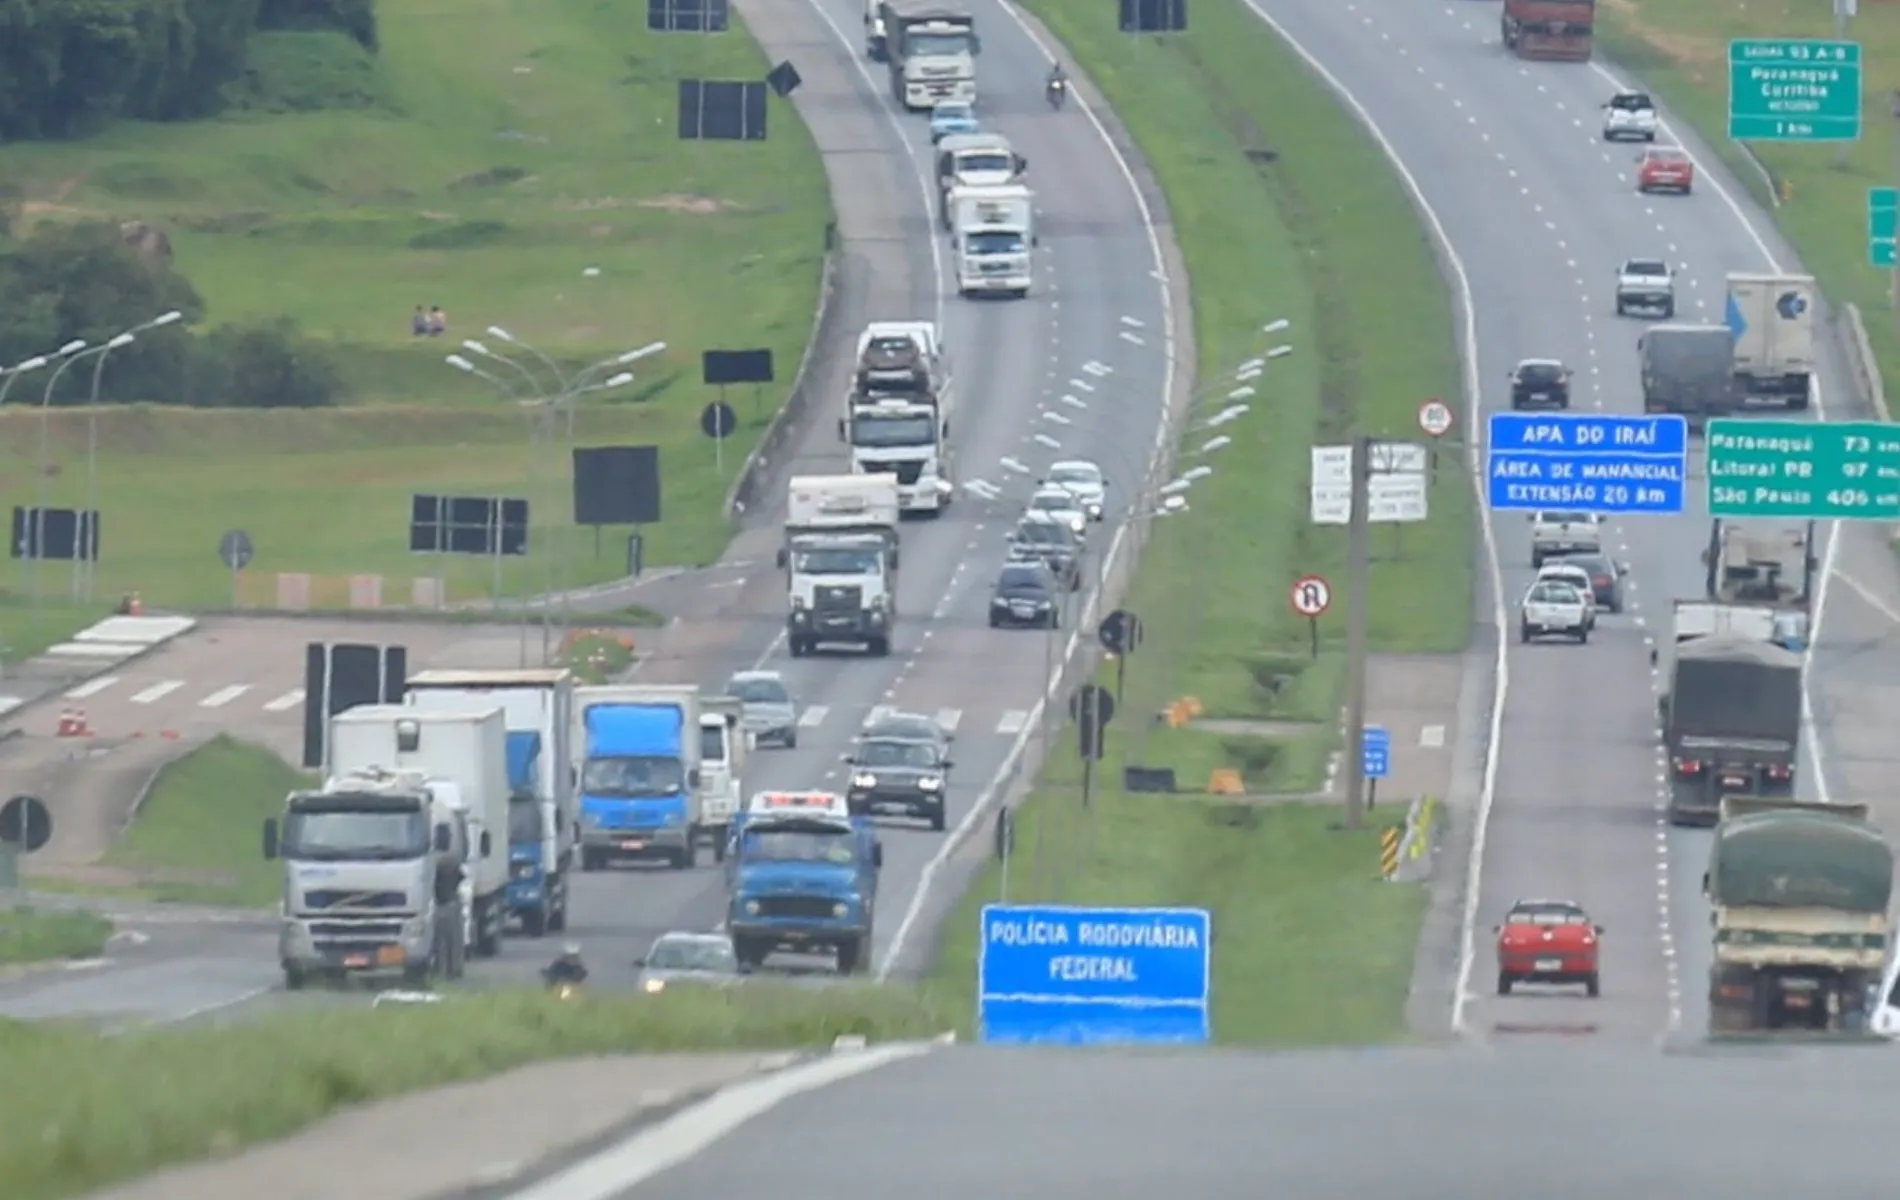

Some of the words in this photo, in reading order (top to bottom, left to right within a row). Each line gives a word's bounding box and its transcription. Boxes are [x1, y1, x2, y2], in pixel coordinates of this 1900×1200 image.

[1751, 66, 1839, 82] Paranaguá
[1761, 82, 1828, 97] Curitiba
[1776, 121, 1783, 135] 1
[1788, 122, 1813, 135] km
[1522, 424, 1564, 444] APA
[1576, 425, 1604, 445] DO
[1615, 421, 1658, 445] IRAÍ
[1711, 433, 1813, 453] Paranaguá
[1842, 435, 1870, 453] 73
[1494, 457, 1542, 478] ÁREA
[1551, 463, 1574, 479] DE
[1582, 464, 1680, 481] MANANCIAL
[1711, 458, 1776, 477] Litoral
[1784, 461, 1813, 478] PR
[1841, 462, 1869, 478] 97
[1507, 482, 1596, 502] EXTENSÃO
[1604, 485, 1628, 504] 20
[1635, 486, 1666, 504] km
[1712, 486, 1747, 504] São
[1755, 487, 1812, 505] Paulo
[991, 915, 1069, 946] POLÍCIA
[1079, 918, 1199, 949] RODOVIÁRIA
[1049, 955, 1138, 981] FEDERAL
